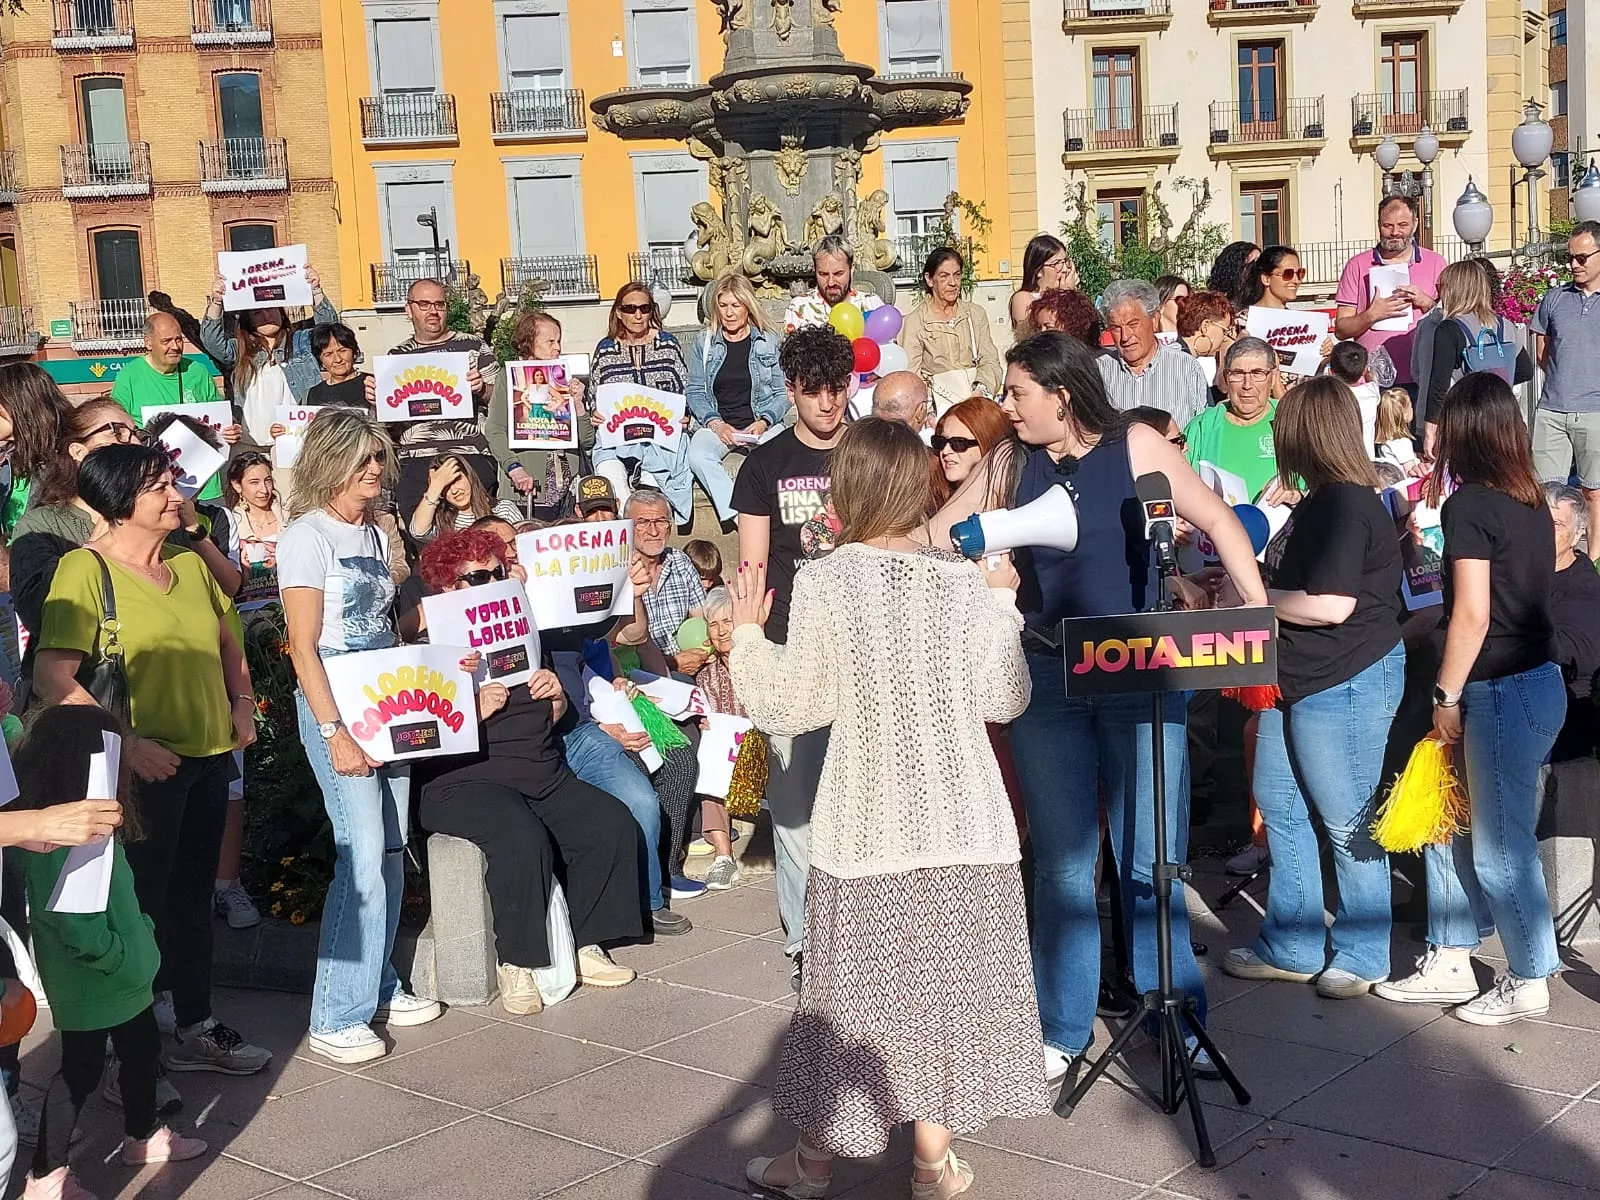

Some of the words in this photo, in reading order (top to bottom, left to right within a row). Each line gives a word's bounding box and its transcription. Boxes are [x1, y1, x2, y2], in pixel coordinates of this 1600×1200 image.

[232, 279, 246, 291] LA
[1266, 323, 1310, 338] LORENA
[394, 365, 459, 387] LORENA
[386, 379, 463, 409] GANADORA
[613, 394, 674, 419] LORENA
[516, 422, 546, 430] LORENA
[547, 423, 569, 431] MATA
[606, 406, 674, 437] GANADORA
[778, 477, 832, 492] LORENA
[778, 491, 821, 508] FINA
[535, 528, 614, 554] LORENA
[619, 527, 628, 545] A
[534, 558, 563, 578] LA
[1425, 553, 1441, 563] VO
[465, 599, 511, 626] VOTA
[512, 596, 522, 615] A
[468, 616, 531, 648] LORENA
[1072, 629, 1271, 675] JOTALENT
[362, 664, 458, 706] LORENA
[351, 688, 464, 741] GANADORA
